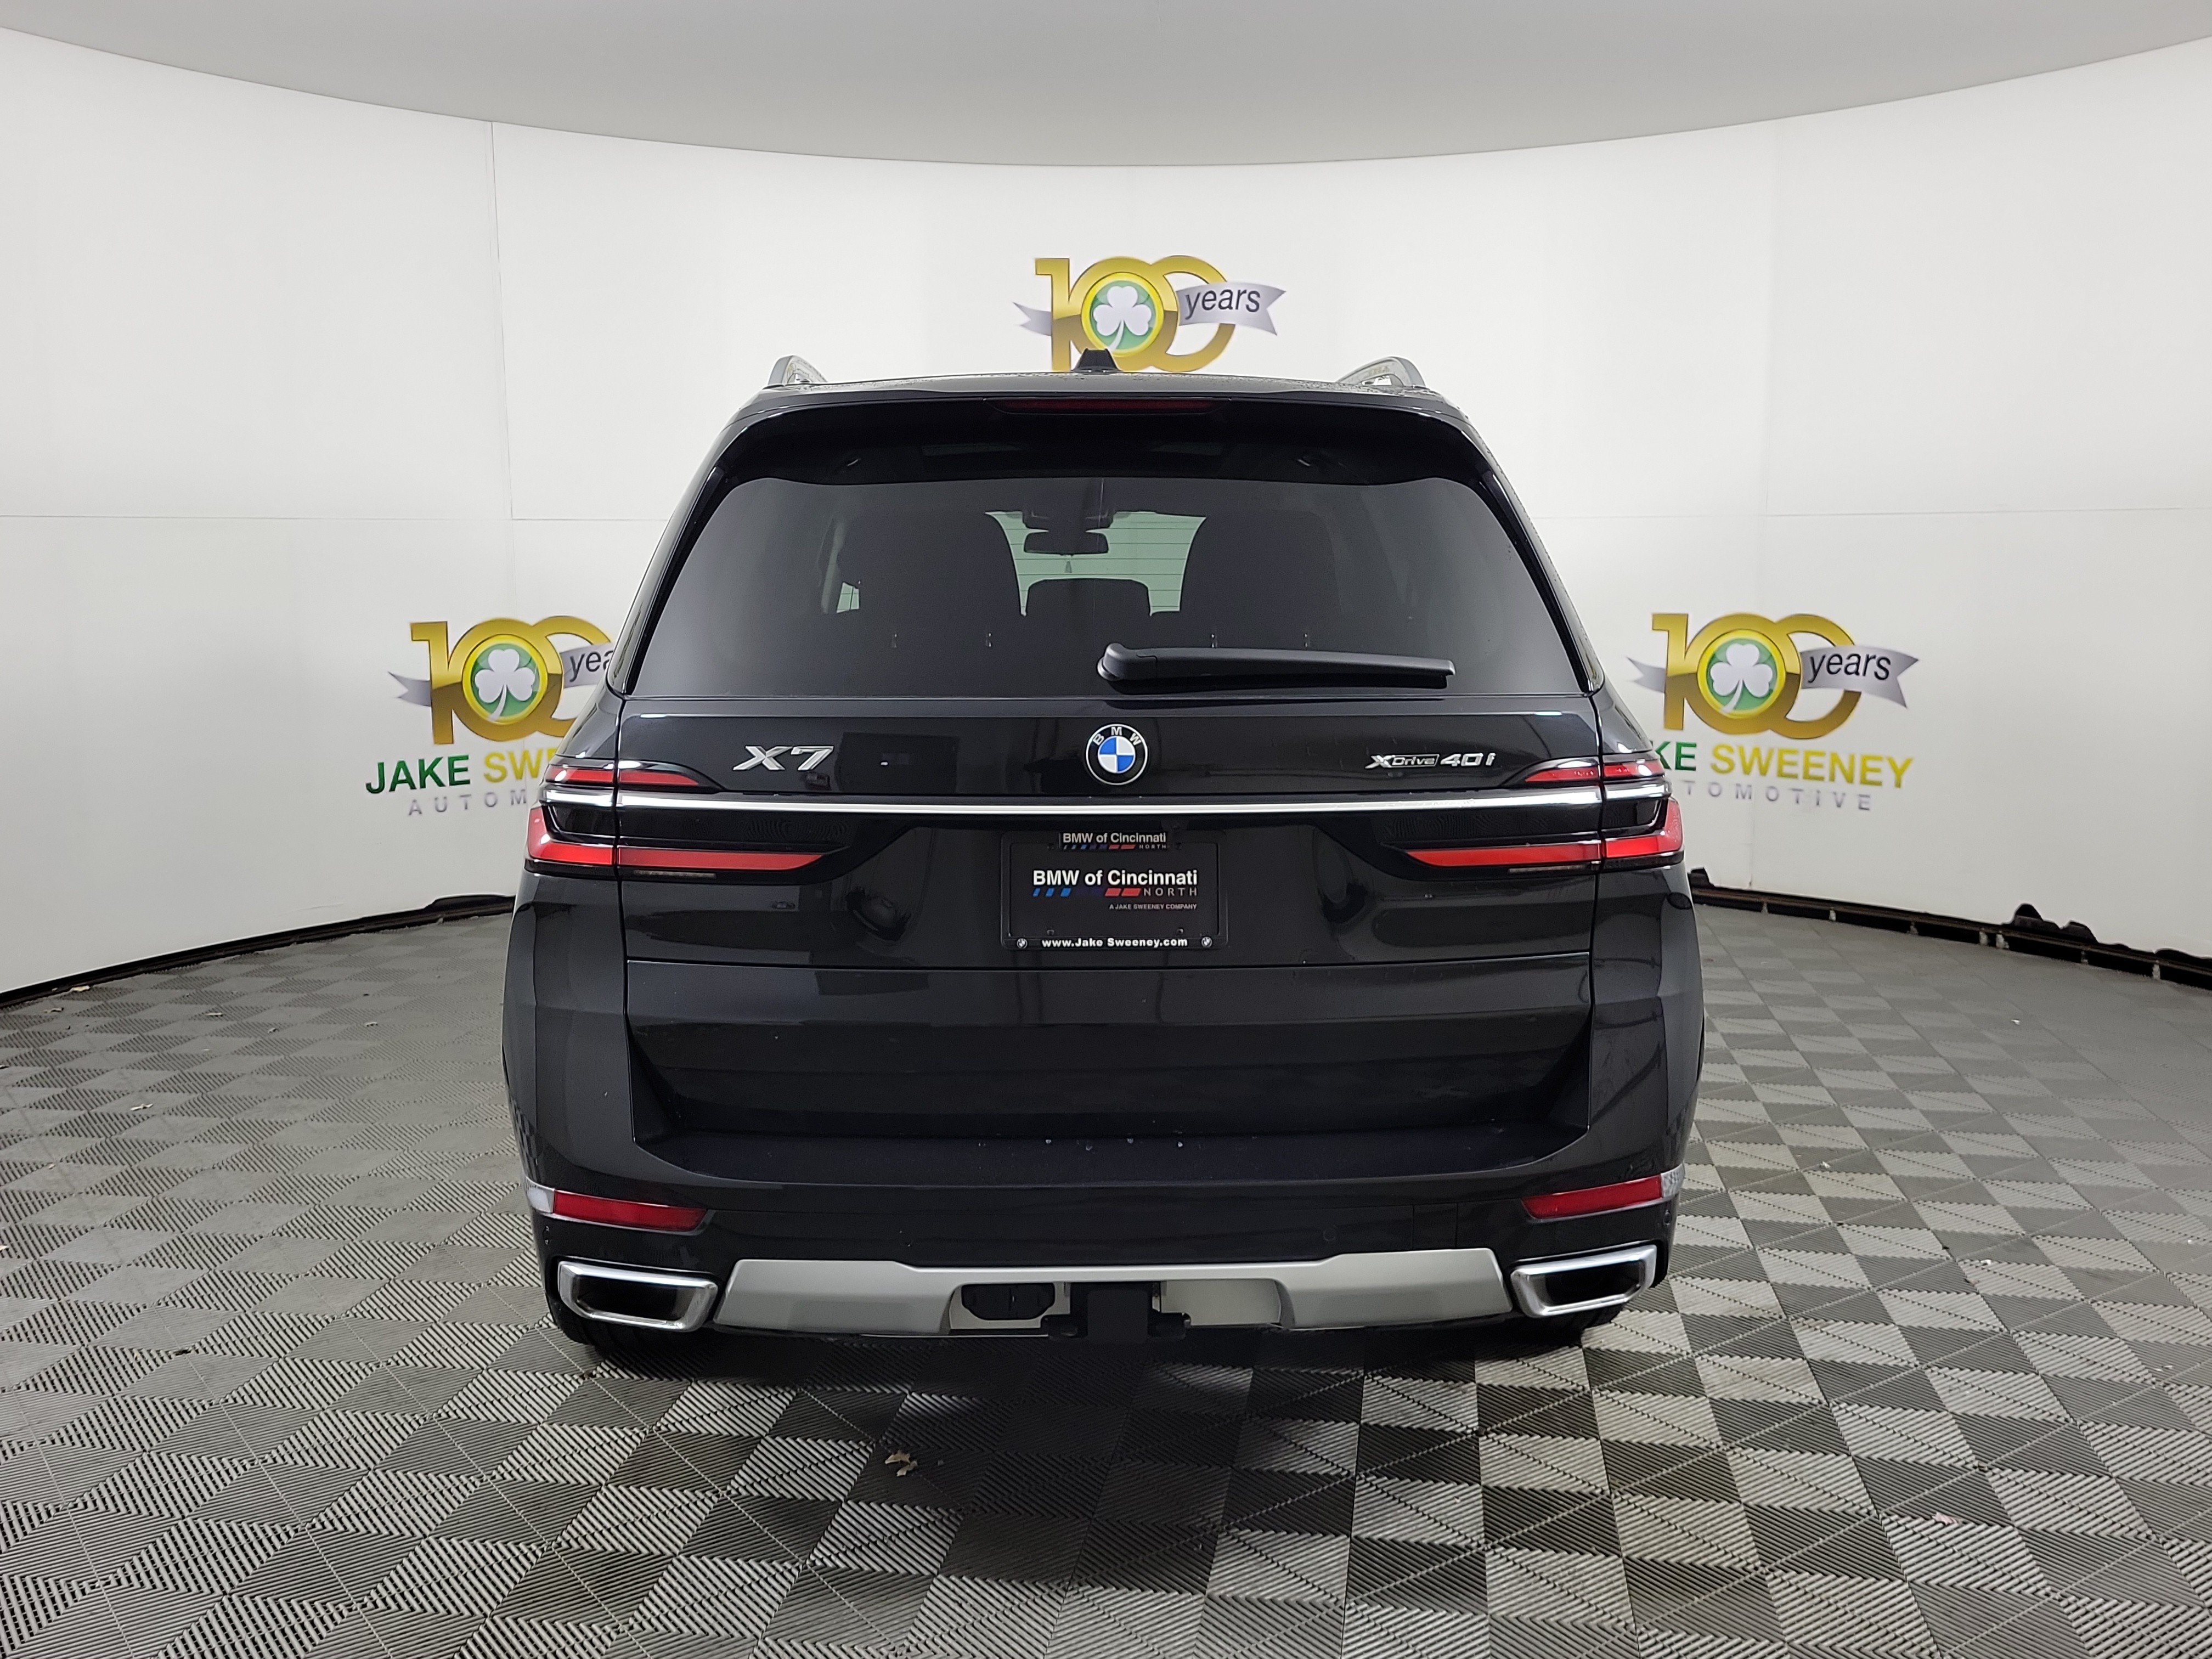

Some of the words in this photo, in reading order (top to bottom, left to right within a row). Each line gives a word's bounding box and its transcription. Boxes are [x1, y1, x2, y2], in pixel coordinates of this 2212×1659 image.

[1184, 289, 1261, 319] years
[1808, 651, 1892, 682] years
[1092, 726, 1142, 746] BMW
[733, 746, 834, 771] X7
[1711, 743, 1914, 789] SWEENEY
[365, 754, 471, 794] JAKE
[484, 749, 557, 783] SW
[1063, 833, 1093, 843] BMW
[1096, 833, 1108, 843] of
[1110, 832, 1166, 843] Cincinnati
[1033, 870, 1080, 885] BMW
[1085, 870, 1103, 885] of
[1108, 870, 1198, 885] Cincinnati
[1143, 888, 1197, 896] NORTH
[1042, 938, 1103, 947] www.Jake
[1107, 938, 1188, 948] Sweeney.com
